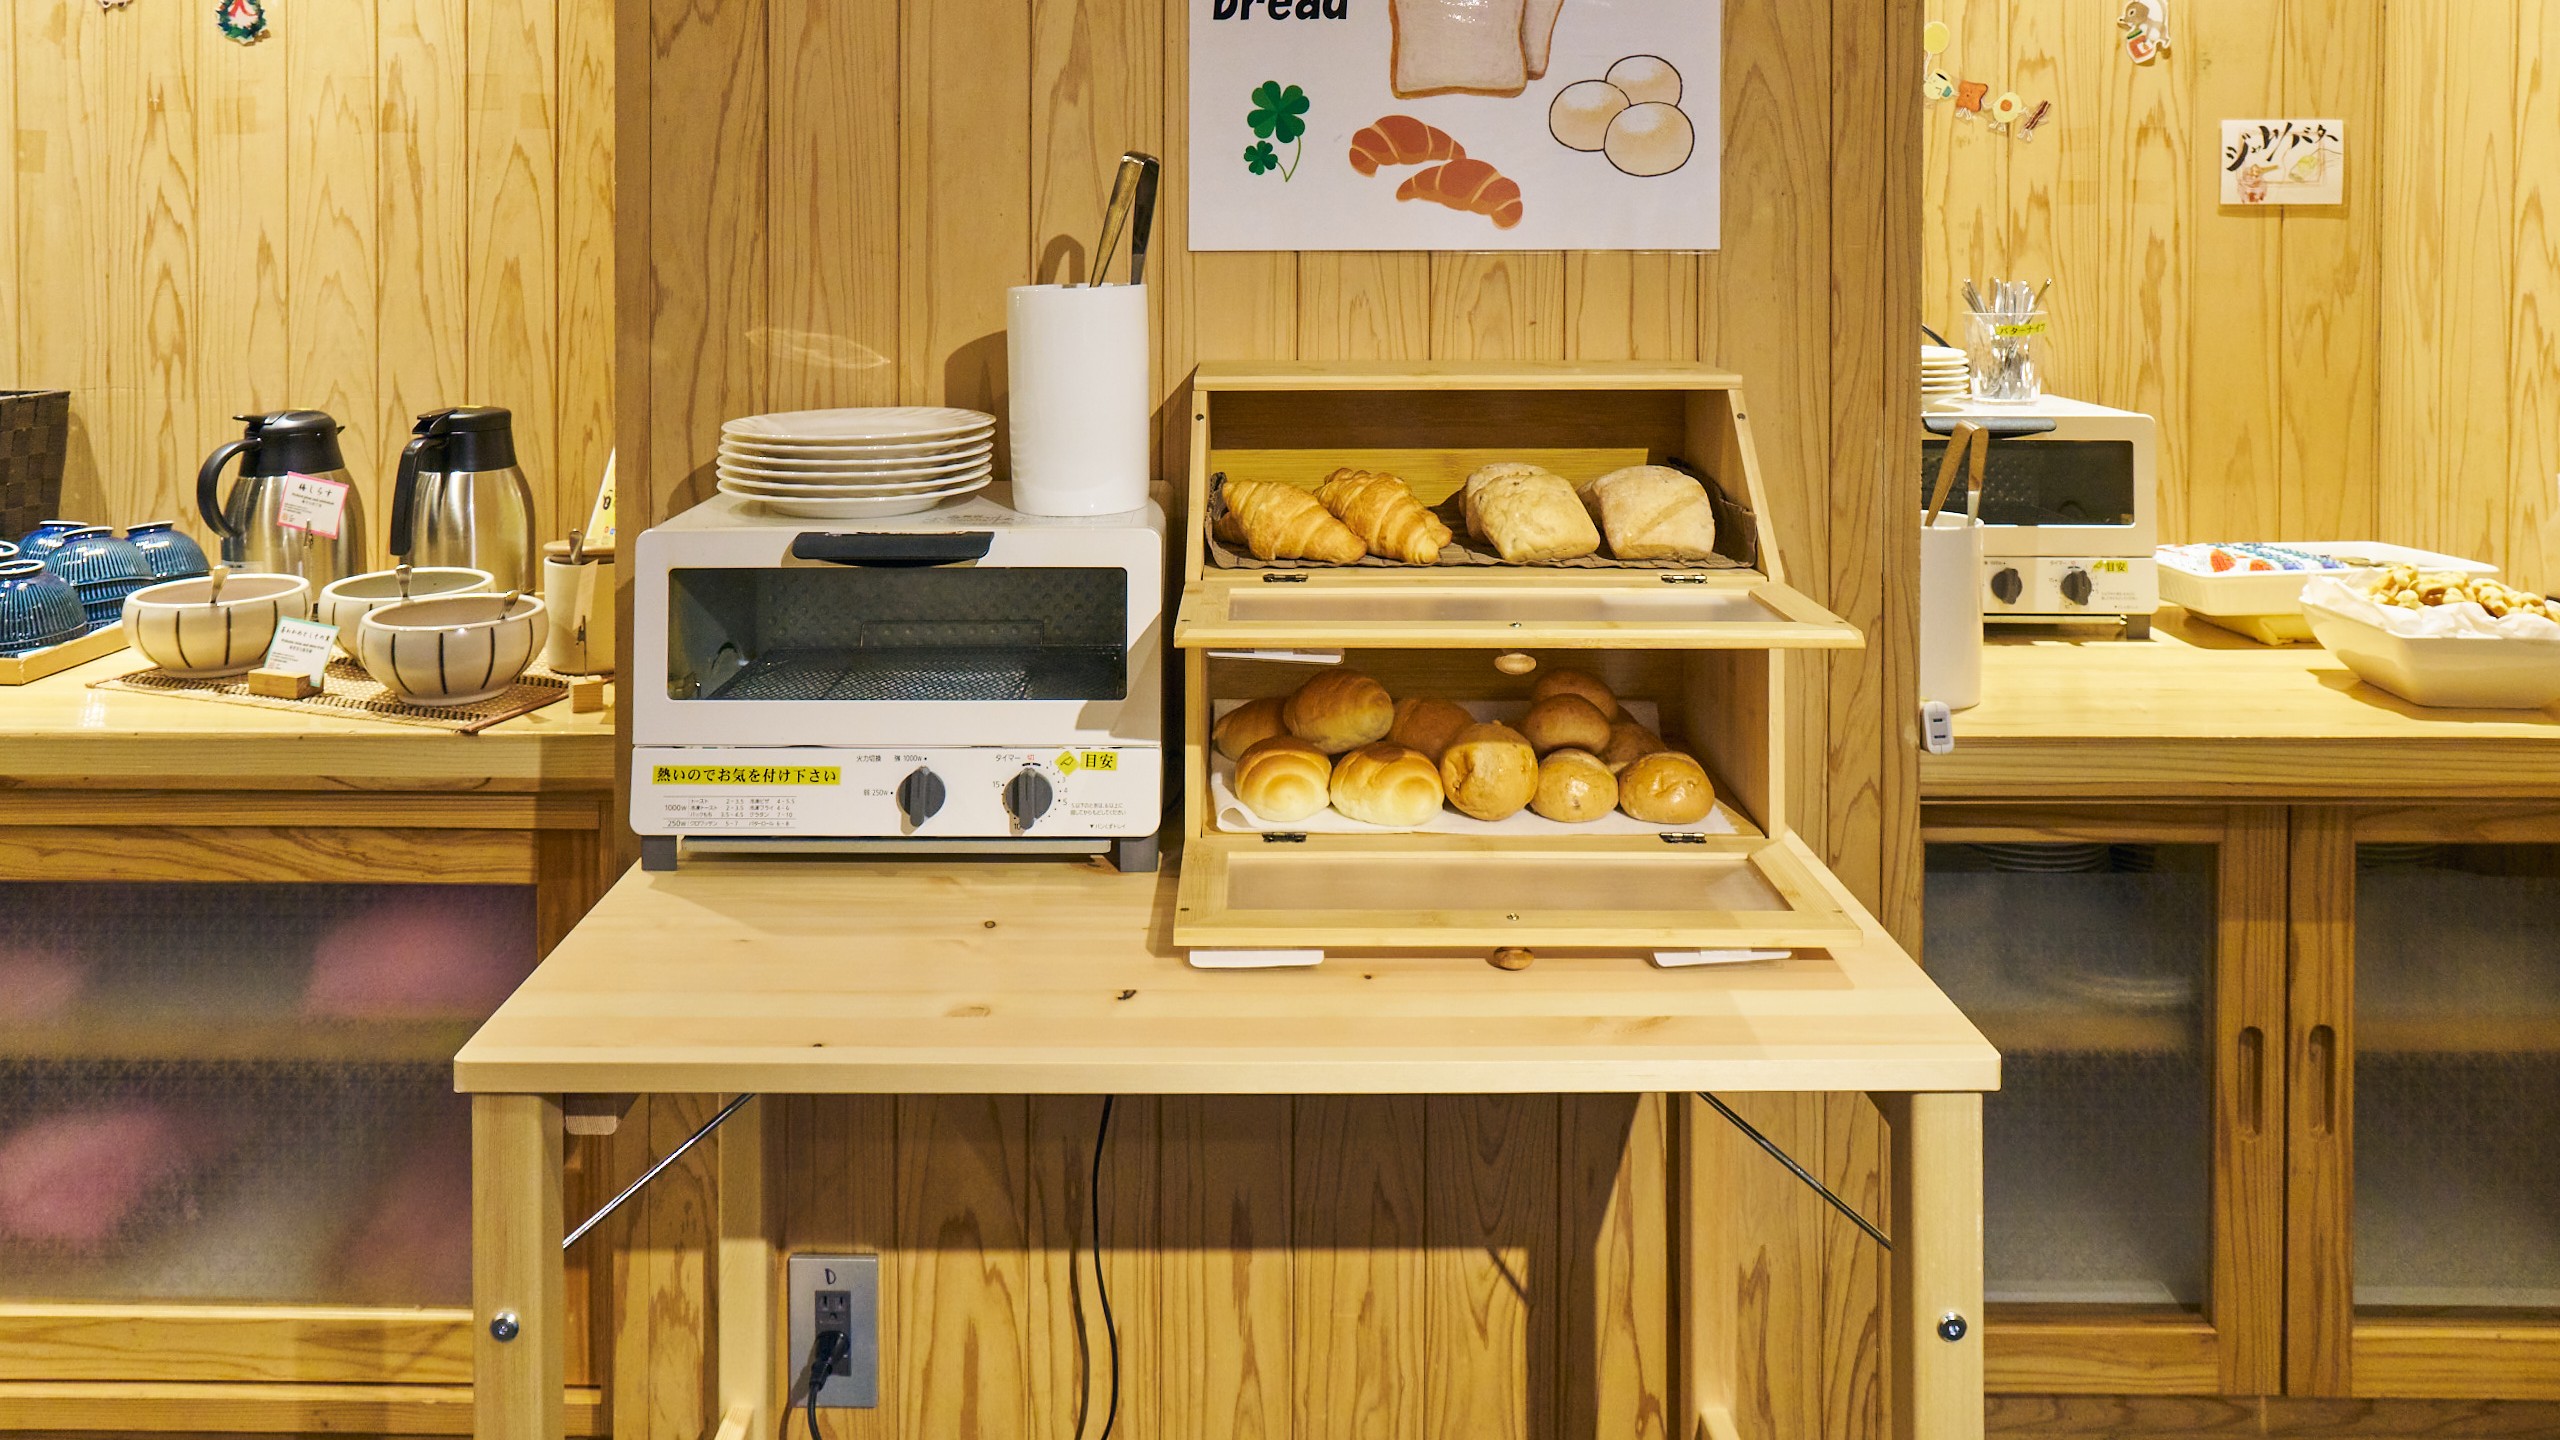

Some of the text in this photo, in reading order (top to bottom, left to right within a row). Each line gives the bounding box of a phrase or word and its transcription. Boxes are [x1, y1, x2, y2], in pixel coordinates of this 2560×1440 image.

[2107, 562, 2126, 573] 目安
[995, 754, 1020, 762] タイマー
[1085, 753, 1114, 769] 目安
[656, 766, 837, 783] 熱いのでお気を付け下さい
